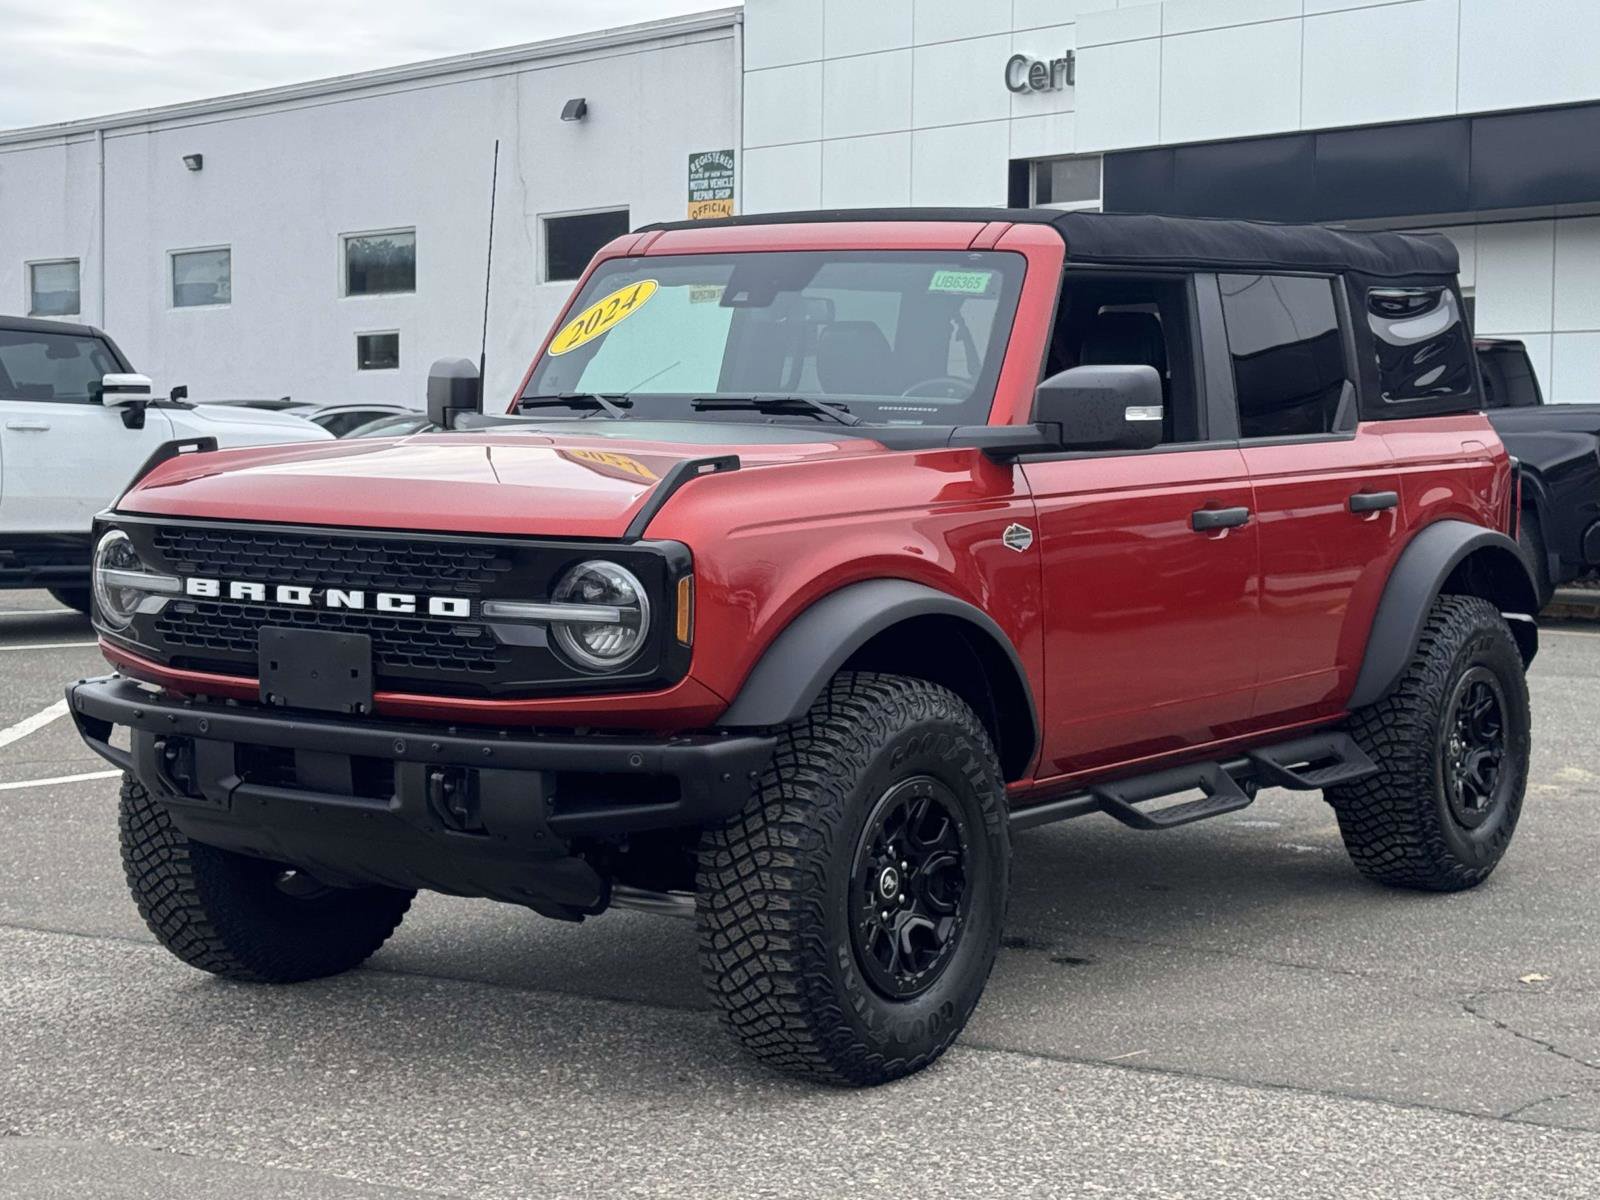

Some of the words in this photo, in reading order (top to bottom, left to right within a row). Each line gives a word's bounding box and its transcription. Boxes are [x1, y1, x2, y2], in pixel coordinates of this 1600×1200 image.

[1004, 49, 1075, 94] Cert
[690, 152, 733, 172] REGISTERED
[690, 180, 708, 190] MOTOR
[710, 178, 733, 188] VEHICLE
[715, 189, 730, 198] SHOP
[693, 203, 731, 219] OFFICIAL
[935, 274, 983, 289] UB6365
[565, 284, 643, 348] 2024
[186, 577, 471, 617] BRONCO
